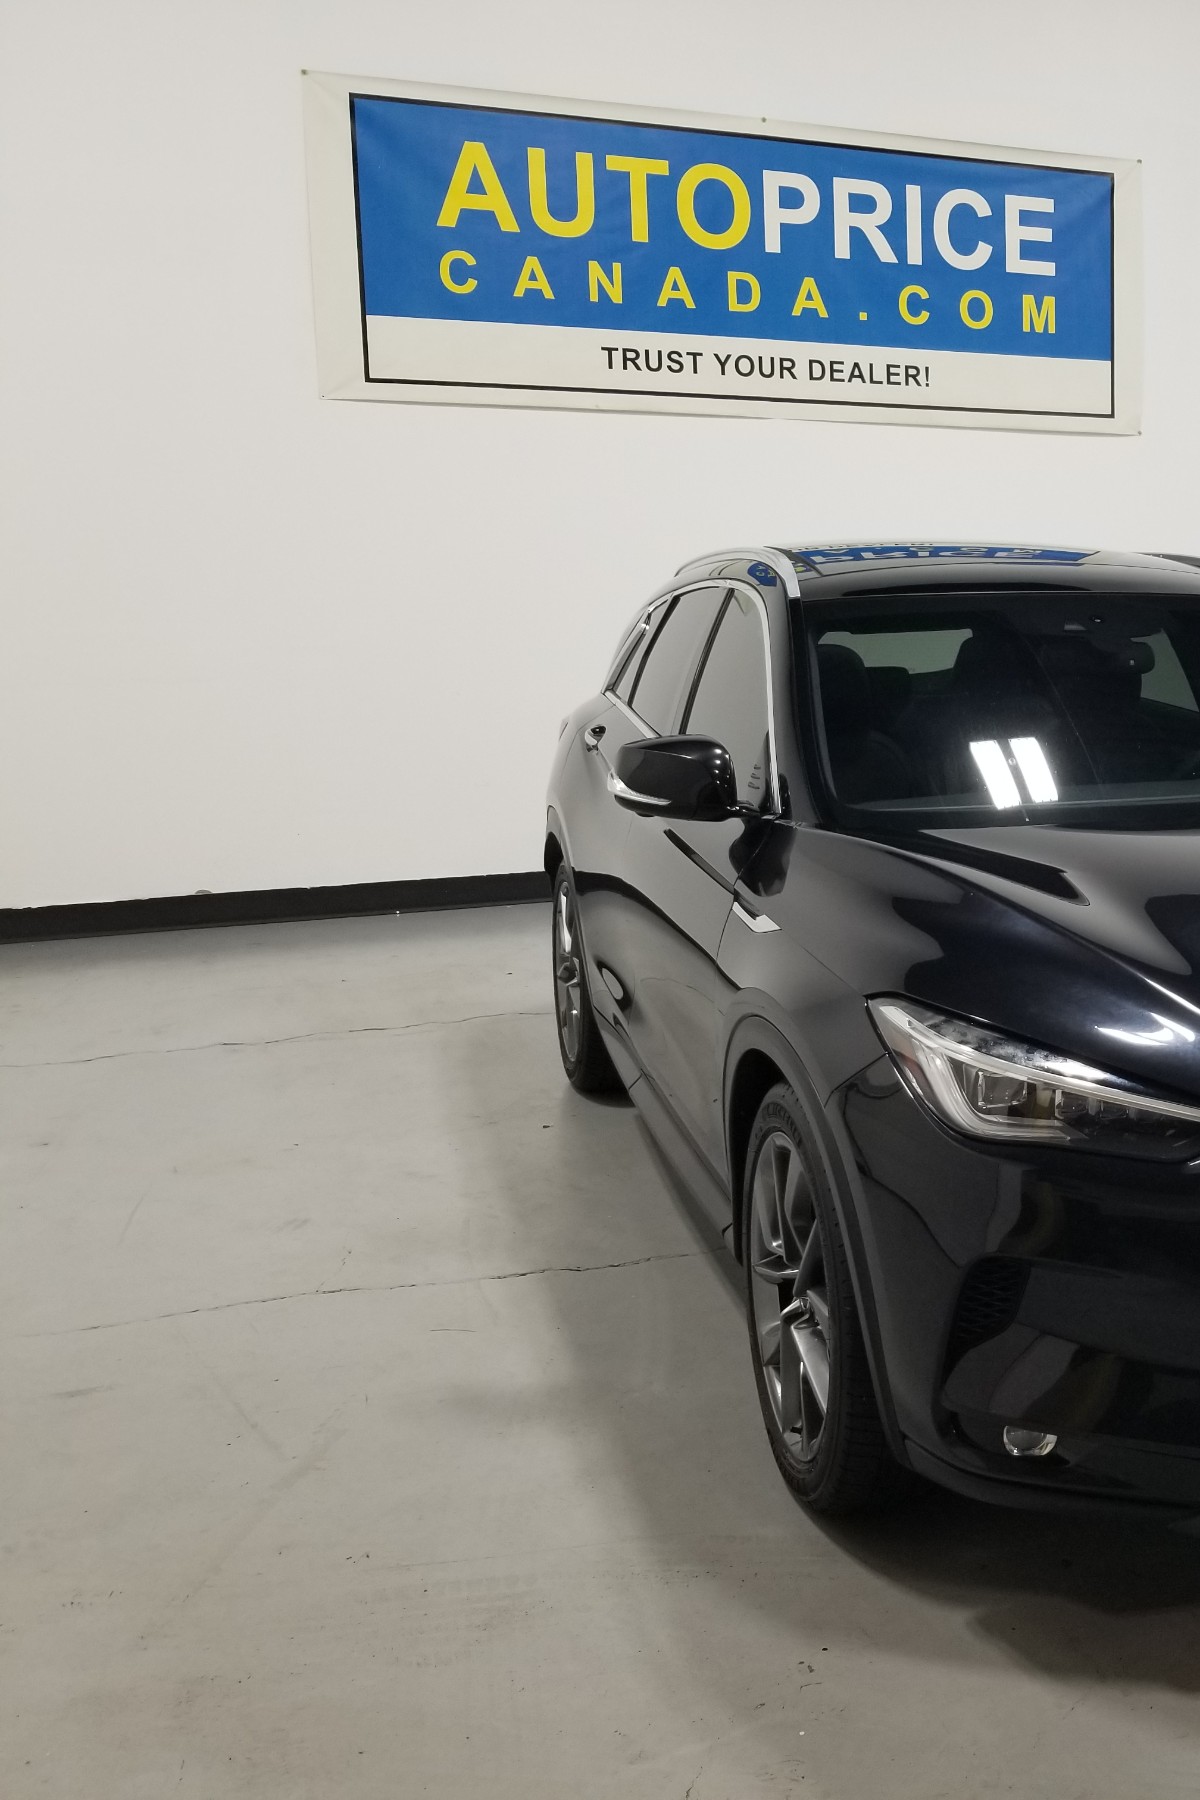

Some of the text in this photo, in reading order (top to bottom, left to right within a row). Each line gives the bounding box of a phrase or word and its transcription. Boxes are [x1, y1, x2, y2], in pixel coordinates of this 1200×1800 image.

[440, 250, 1056, 334] CANADA.COM
[600, 346, 931, 387] TRUST YOUR DEALER!
